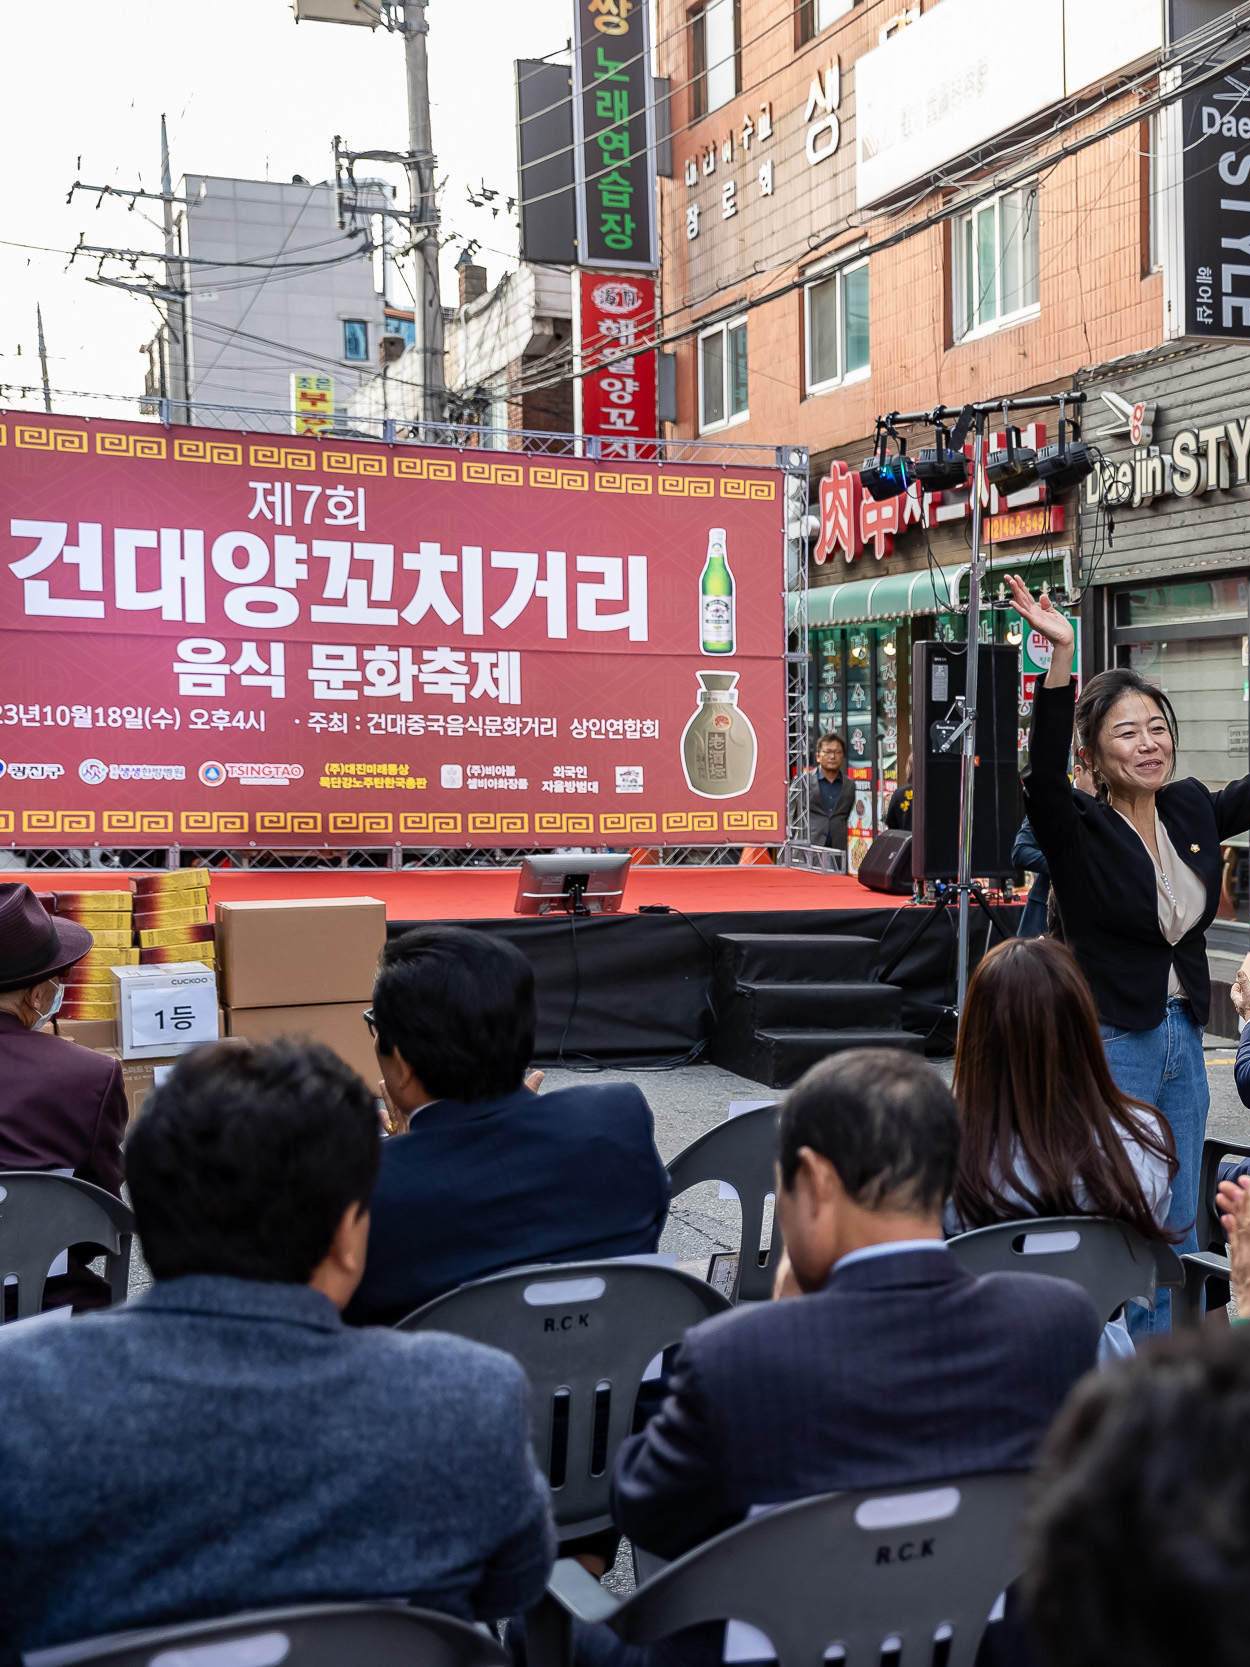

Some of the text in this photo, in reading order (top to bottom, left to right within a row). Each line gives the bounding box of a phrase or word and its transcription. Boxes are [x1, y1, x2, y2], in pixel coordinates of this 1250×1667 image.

[593, 46, 637, 251] 노래연습장
[1196, 266, 1213, 326] 헤어샵
[247, 480, 367, 532] 제7회
[8, 518, 649, 642] 건대양꼬치거리
[172, 637, 522, 705] 음식 문화축제
[188, 708, 267, 732] 오후4시
[307, 711, 660, 740] 주최 건대중국음식문화거리 상인연합회
[11, 764, 63, 779] 광진구
[226, 764, 303, 778] TSINGTAO
[552, 765, 588, 779] 외국인
[171, 977, 208, 986] CUCKOO
[154, 1005, 196, 1031] 1등
